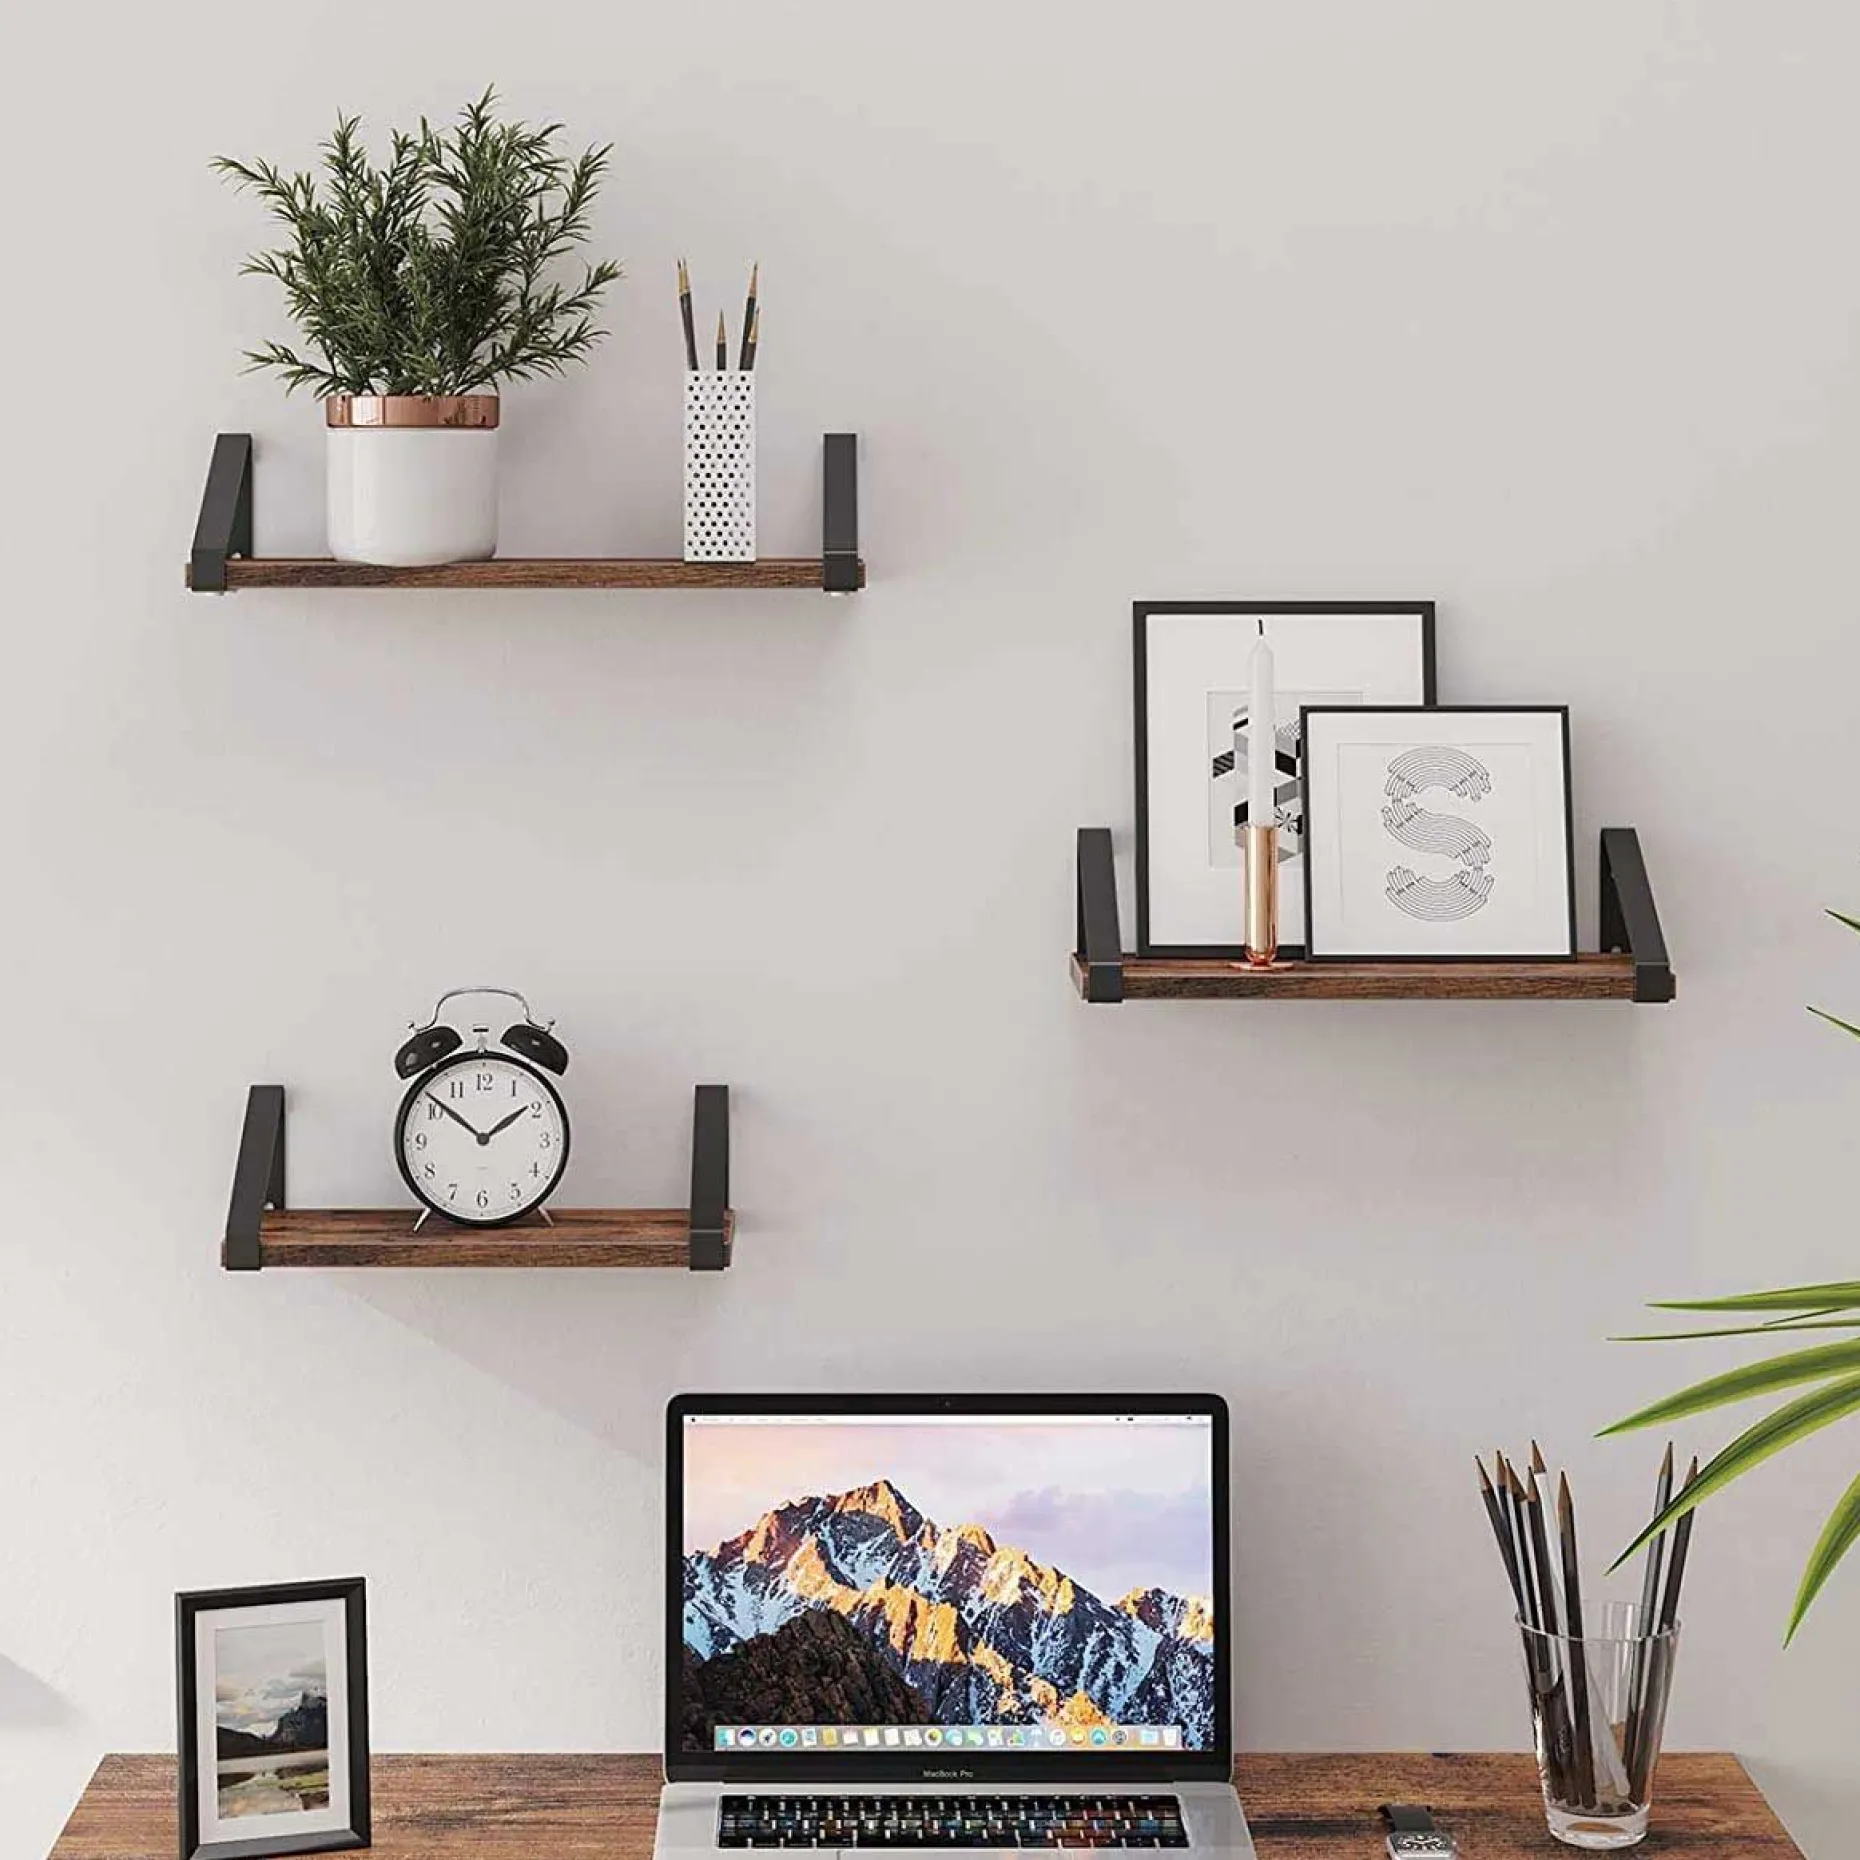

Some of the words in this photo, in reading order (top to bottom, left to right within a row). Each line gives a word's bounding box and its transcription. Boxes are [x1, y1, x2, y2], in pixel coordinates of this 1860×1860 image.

[1381, 745, 1495, 923] S
[450, 1081, 464, 1098] 11
[476, 1074, 493, 1091] 12
[510, 1080, 517, 1097] 1
[427, 1103, 444, 1120] 10
[530, 1102, 542, 1119] 2
[414, 1133, 428, 1150] 9
[539, 1132, 551, 1149] 3
[424, 1162, 436, 1179] 8
[529, 1162, 540, 1178] 4
[447, 1183, 459, 1201] 7
[476, 1190, 488, 1207] 6
[510, 1183, 521, 1200] 5
[923, 1769, 958, 1778] MacBook
[959, 1769, 974, 1778] Pro
